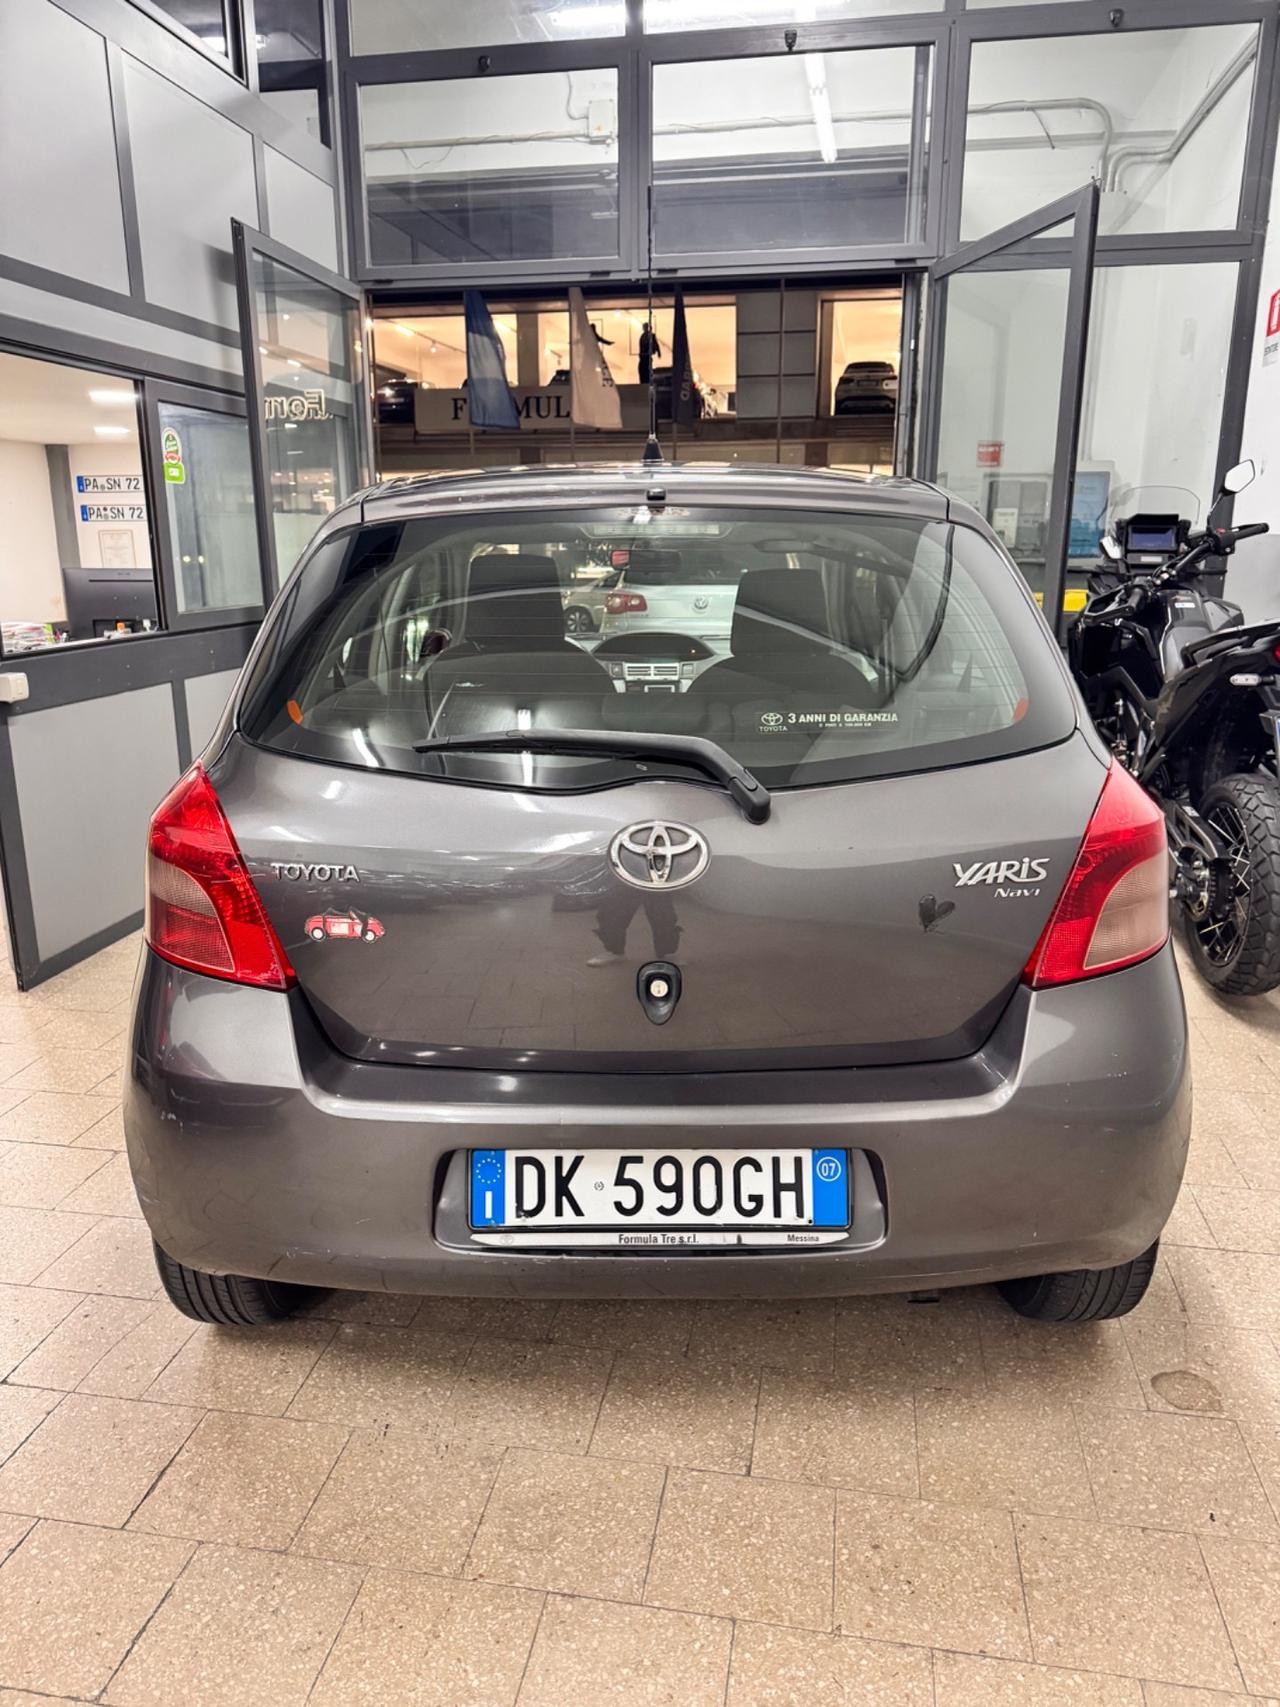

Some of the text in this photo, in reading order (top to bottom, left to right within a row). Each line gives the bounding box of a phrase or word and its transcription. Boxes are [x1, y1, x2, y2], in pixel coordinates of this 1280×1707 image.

[451, 396, 571, 421] FMUL
[84, 477, 140, 490] PA SN 72
[88, 506, 144, 519] PA SN 72
[788, 712, 898, 724] 3 ANNI DI GARANZIA
[270, 862, 360, 882] TOYOTA
[821, 1162, 836, 1177] 07
[515, 1155, 585, 1219] DK
[613, 1155, 805, 1219] 590GH
[618, 1233, 658, 1245] Formula
[660, 1233, 677, 1245] Tre
[786, 1234, 820, 1242] Messina
